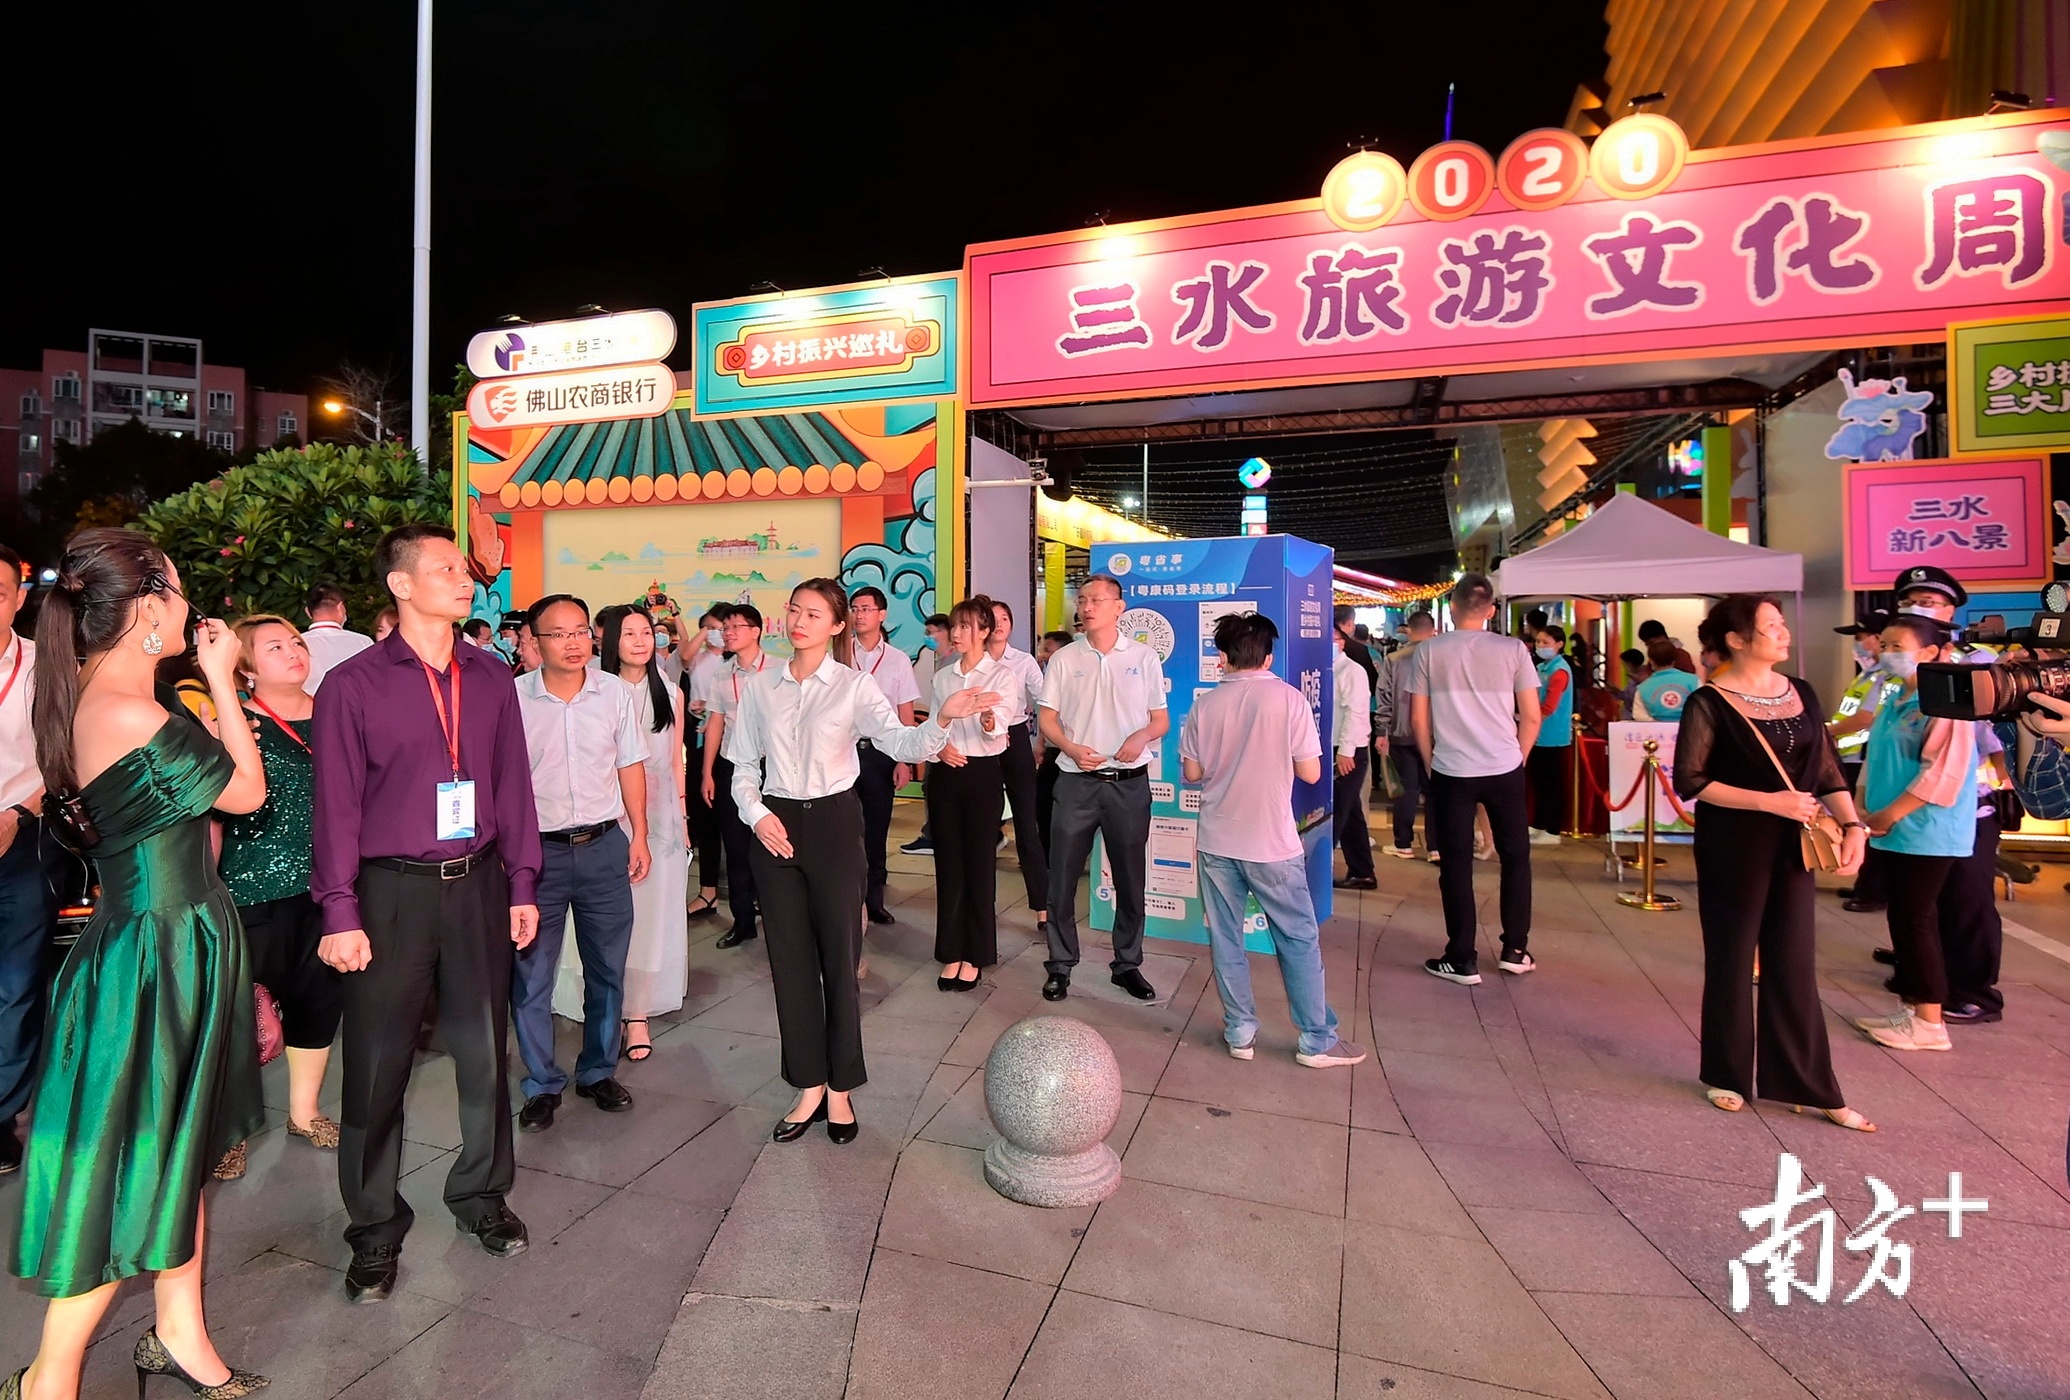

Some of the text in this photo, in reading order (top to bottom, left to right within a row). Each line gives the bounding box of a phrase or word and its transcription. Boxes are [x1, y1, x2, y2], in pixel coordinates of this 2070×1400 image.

[1346, 131, 1659, 219] 2020
[1056, 168, 2053, 357] 三水旅游文化周
[750, 329, 904, 371] 乡村振兴巡礼
[526, 378, 657, 413] 佛山农商银行
[1909, 496, 1989, 521] 三水
[1889, 524, 2010, 553] 新八景
[2044, 624, 2053, 636] 3
[1100, 888, 1109, 899] 5
[1255, 916, 1266, 928] 6
